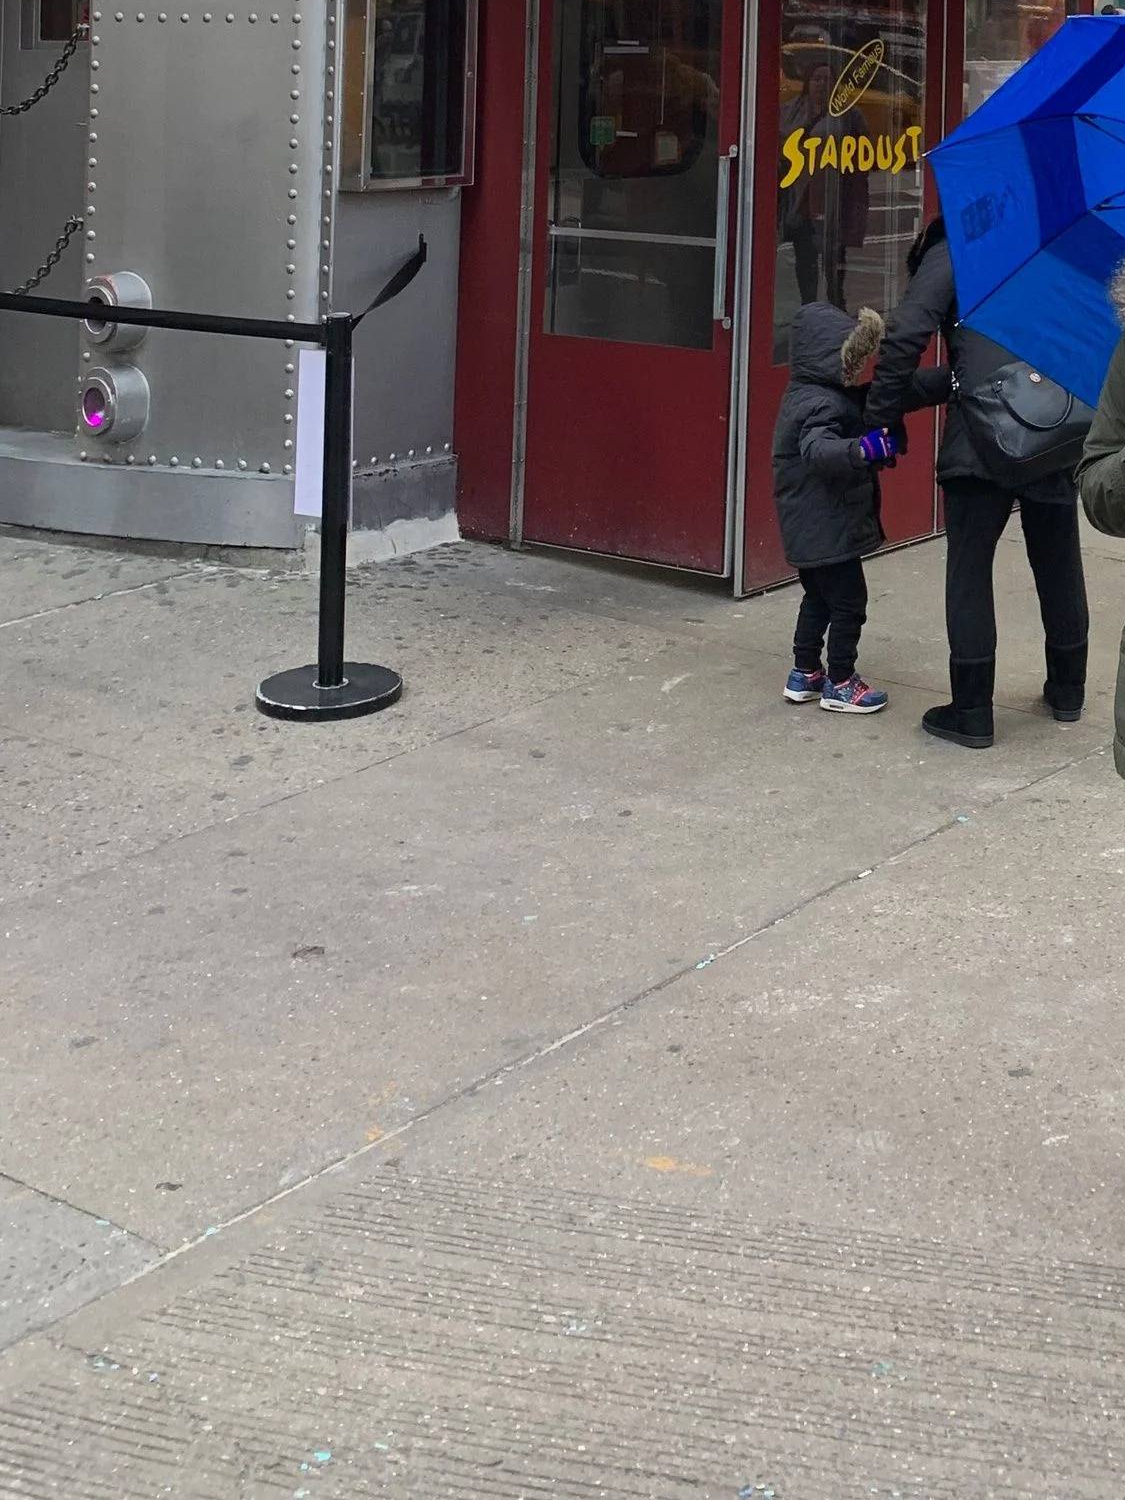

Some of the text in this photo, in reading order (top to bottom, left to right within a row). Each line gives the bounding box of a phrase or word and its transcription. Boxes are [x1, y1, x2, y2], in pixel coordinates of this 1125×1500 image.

[831, 43, 883, 112] World Famous
[779, 125, 923, 189] STARDUST
